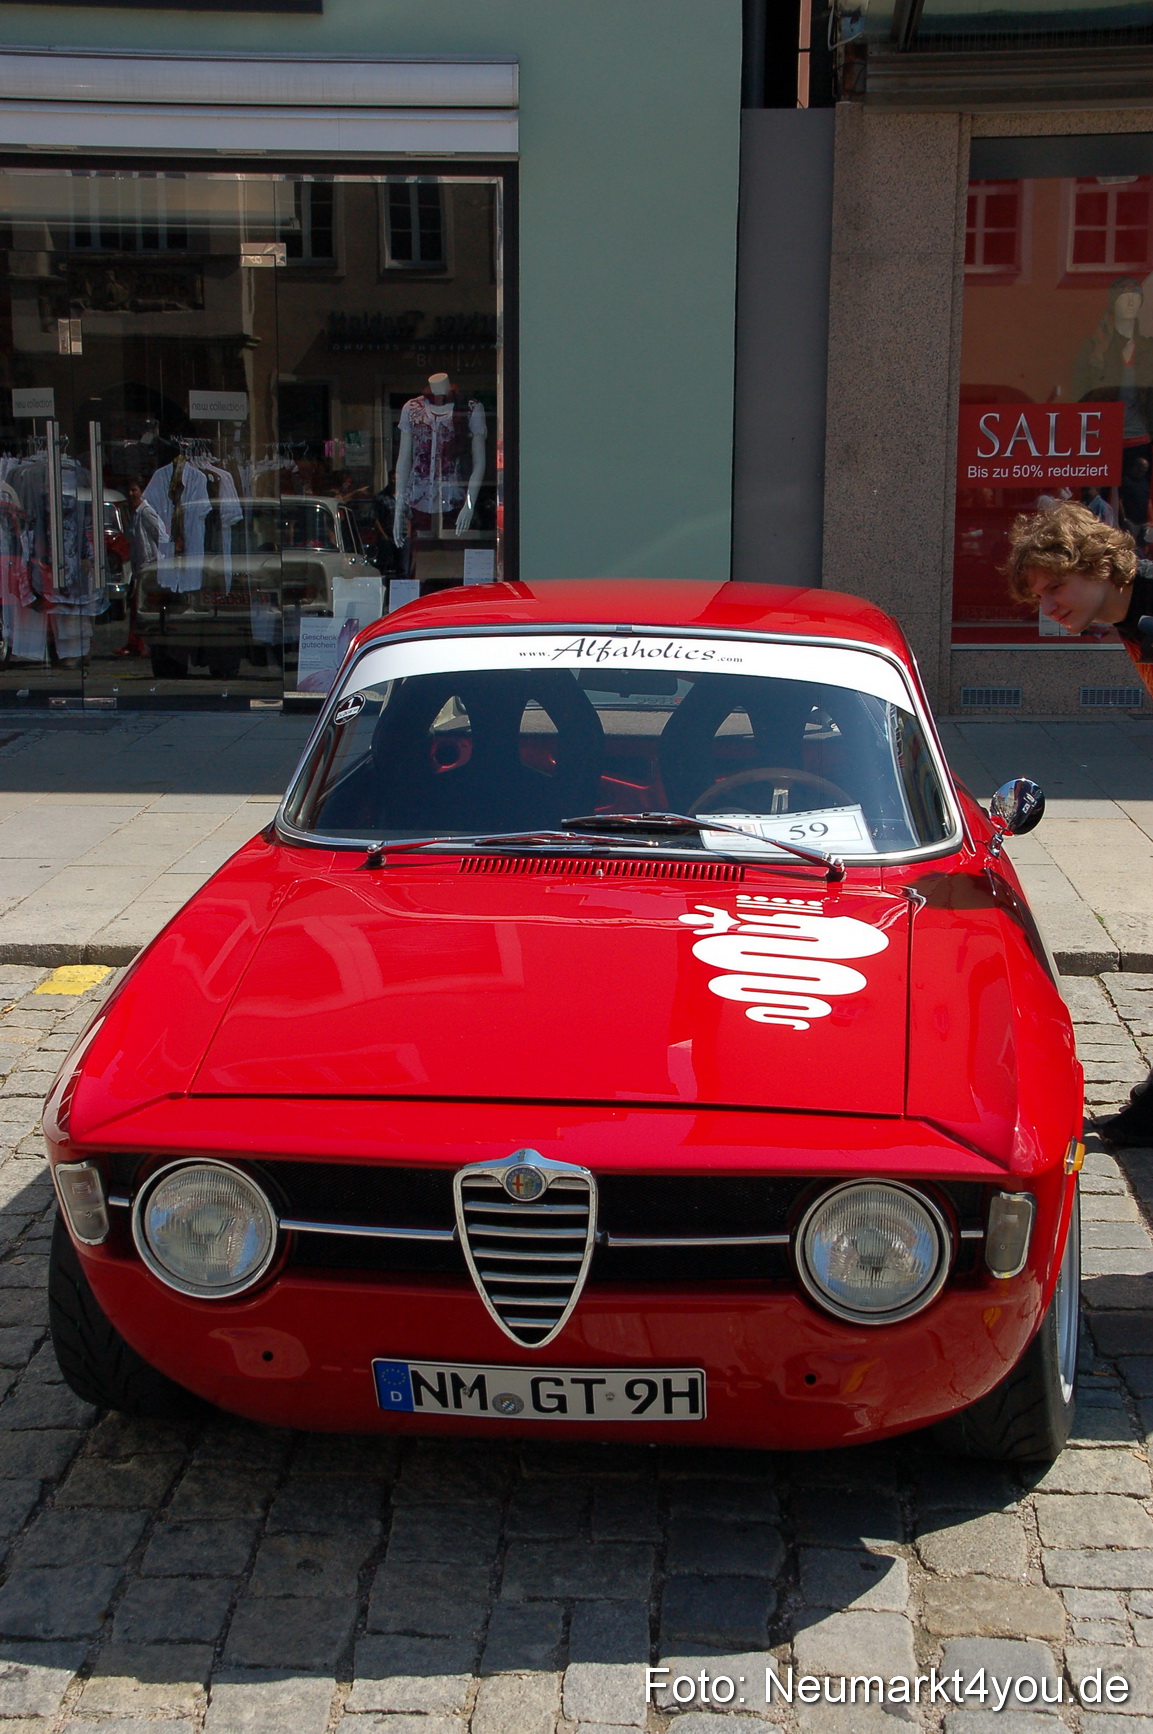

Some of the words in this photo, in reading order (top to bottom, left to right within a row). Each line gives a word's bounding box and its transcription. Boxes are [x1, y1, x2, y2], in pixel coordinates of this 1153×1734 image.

[191, 402, 208, 411] new
[209, 400, 245, 412] collection
[977, 412, 1102, 458] SALE
[967, 465, 988, 478] Bis
[992, 467, 1009, 478] zu
[1012, 465, 1044, 478] 50%
[1047, 464, 1109, 477] reduziert
[788, 822, 829, 840] 59
[390, 1390, 403, 1402] D
[410, 1370, 488, 1411] NM
[530, 1376, 606, 1414] GT
[624, 1377, 700, 1415] 9H
